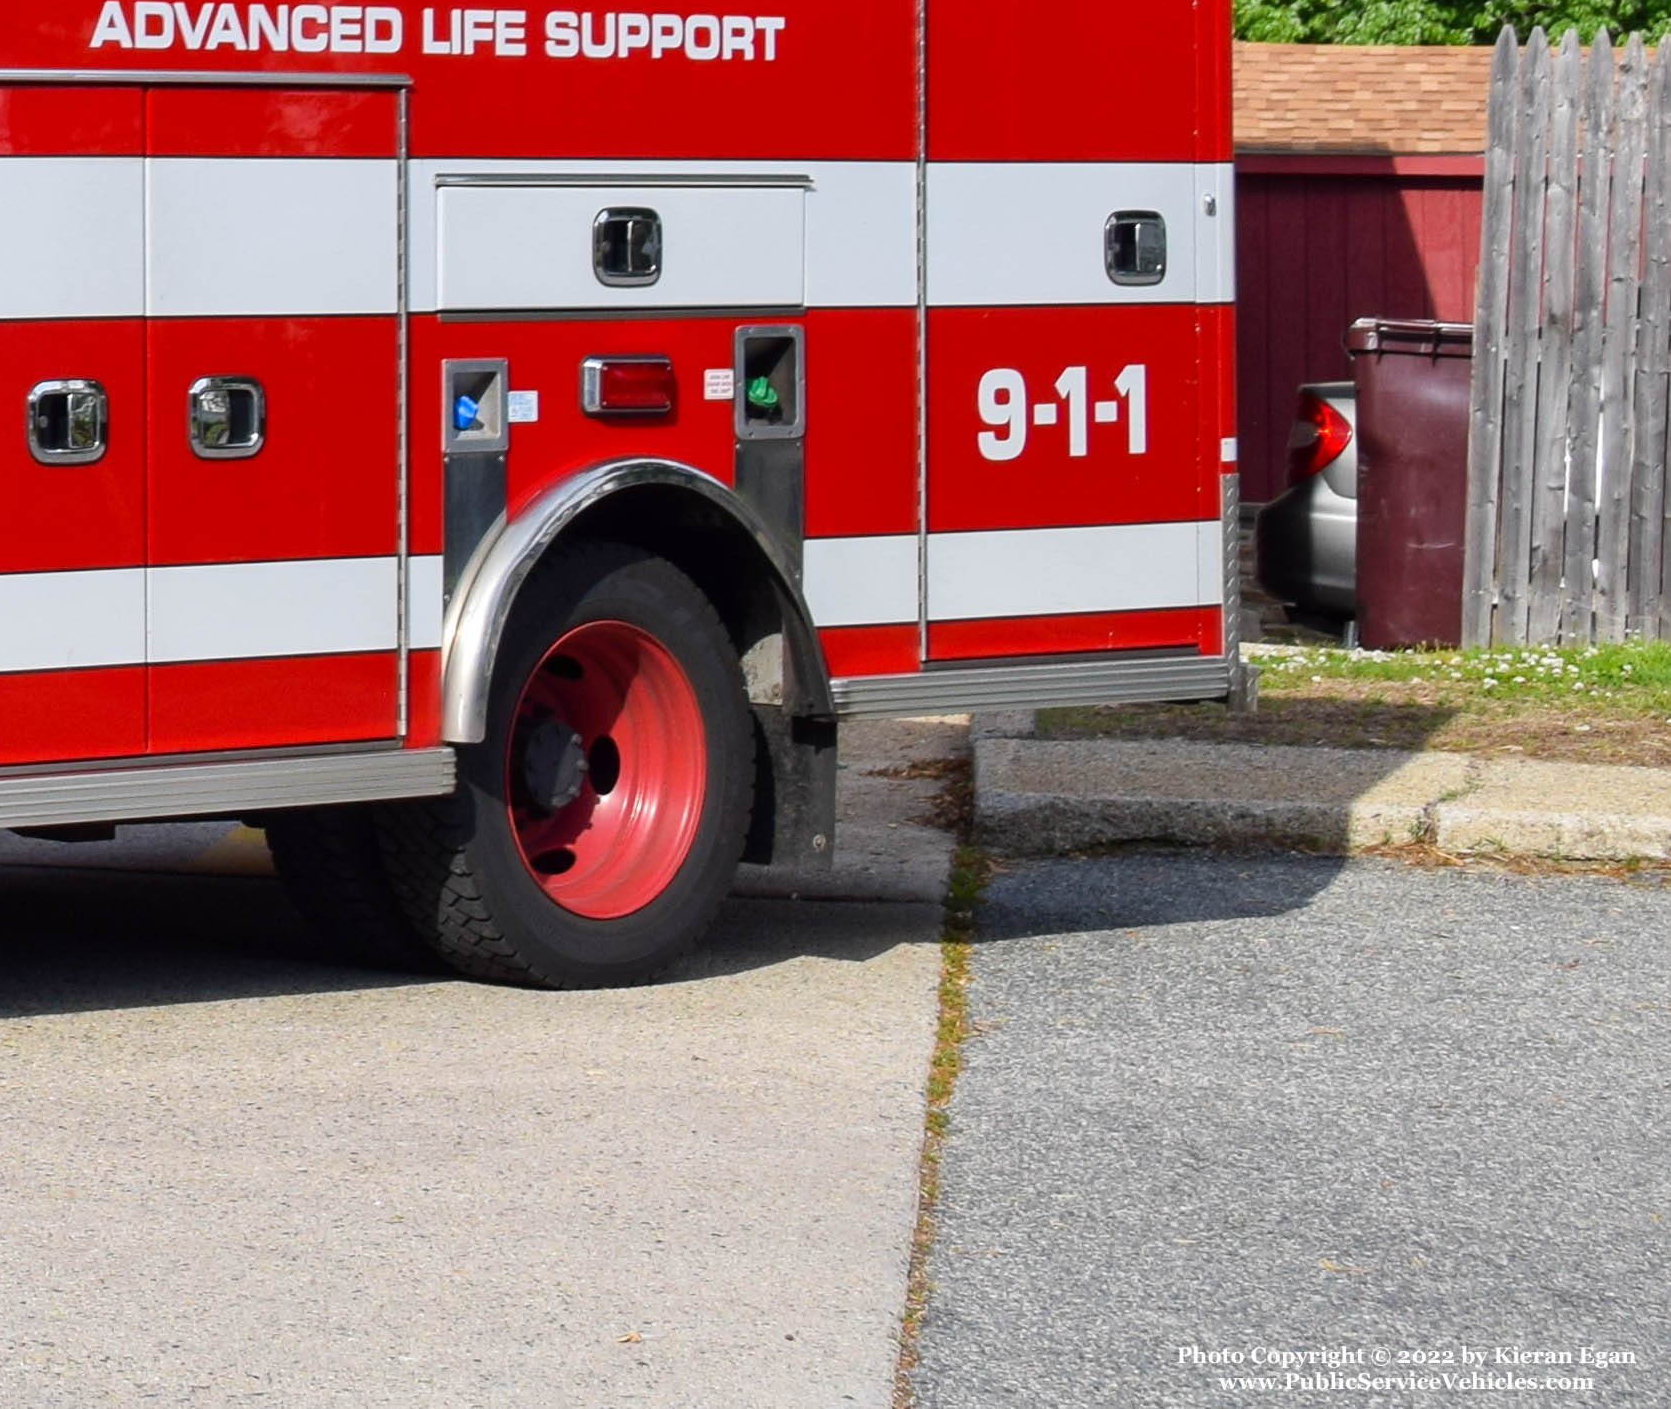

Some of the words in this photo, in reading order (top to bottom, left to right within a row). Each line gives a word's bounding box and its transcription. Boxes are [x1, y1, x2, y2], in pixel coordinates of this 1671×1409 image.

[89, 0, 403, 53] ADVANCED
[421, 8, 528, 57] LIFE
[544, 11, 786, 62] SUPPORT
[977, 364, 1147, 461] 9-1-1
